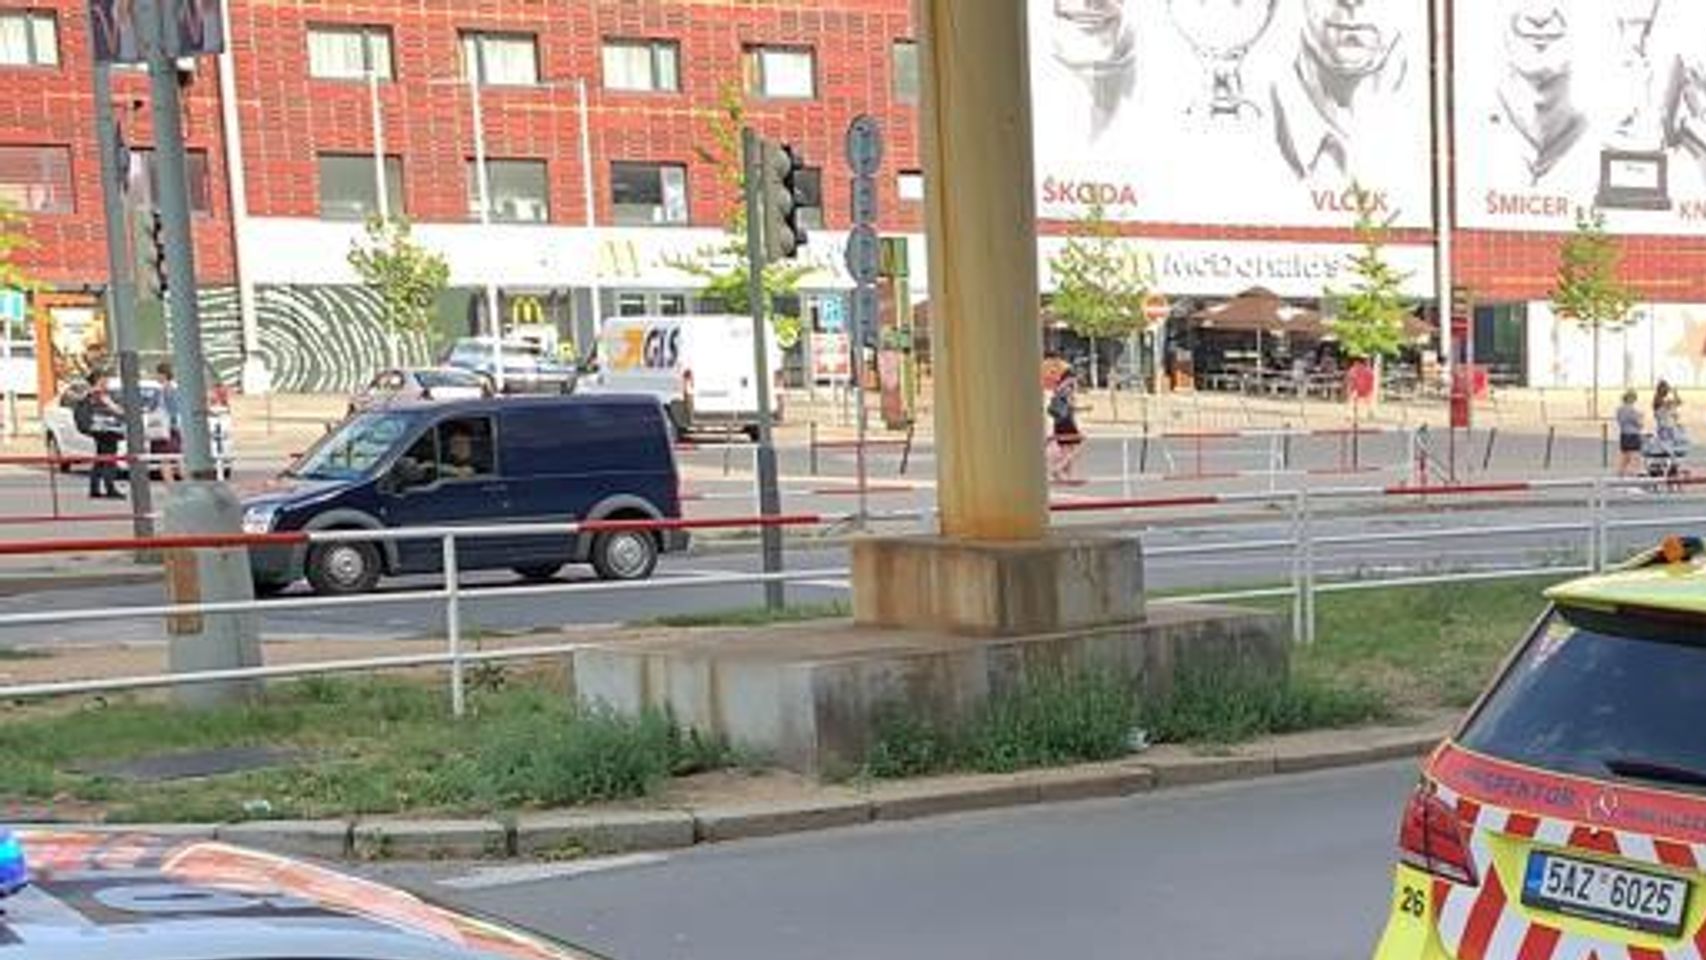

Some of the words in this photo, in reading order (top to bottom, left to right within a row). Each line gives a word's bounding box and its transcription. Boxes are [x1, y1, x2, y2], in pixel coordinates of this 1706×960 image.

[1043, 178, 1137, 206] ŠKODA
[1486, 190, 1568, 215] ŠMICER
[644, 325, 682, 368] GLS
[1400, 885, 1425, 917] 26
[1546, 860, 1595, 901] 5AZ
[1610, 873, 1676, 917] 6025
